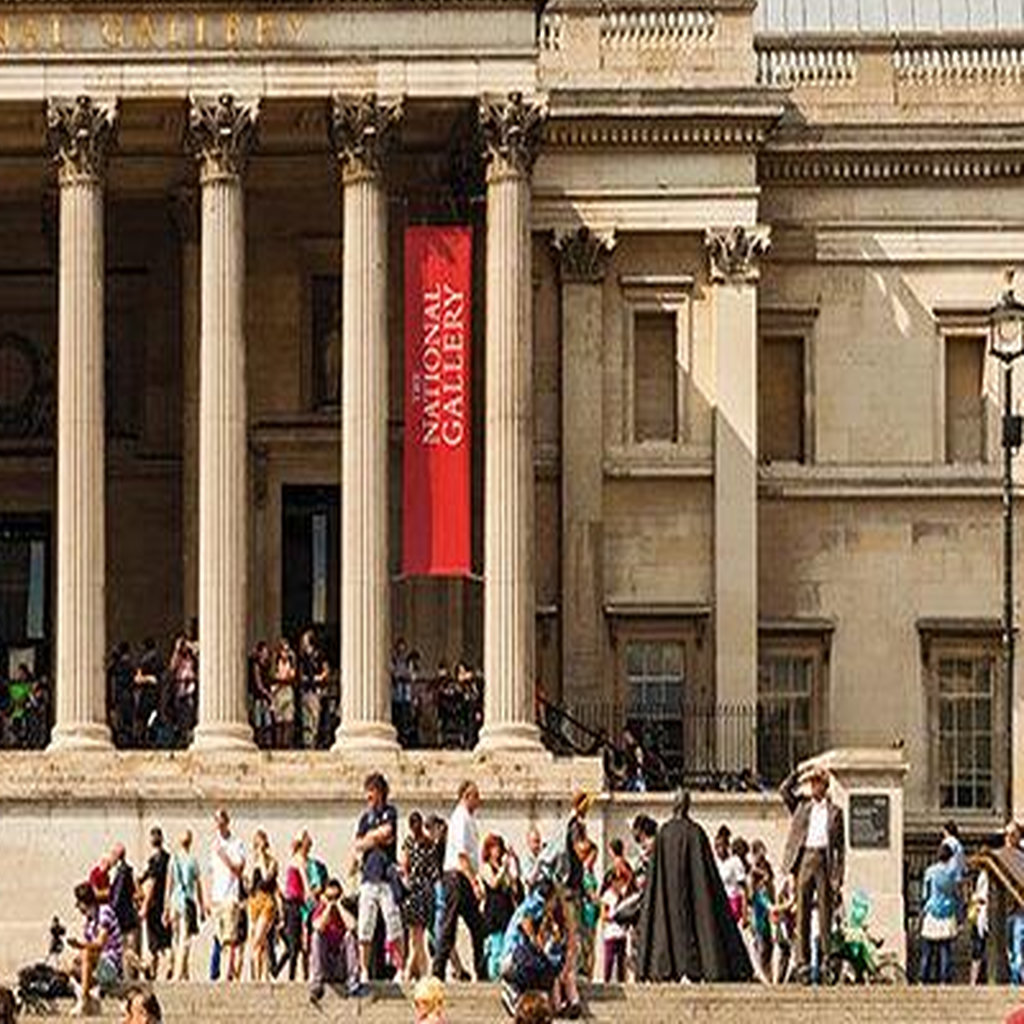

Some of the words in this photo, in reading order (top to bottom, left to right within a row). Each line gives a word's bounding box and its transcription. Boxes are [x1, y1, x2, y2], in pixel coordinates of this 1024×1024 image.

[100, 12, 307, 48] GALLERY
[423, 282, 441, 446] NATIONAL
[441, 283, 465, 447] GALLERY
